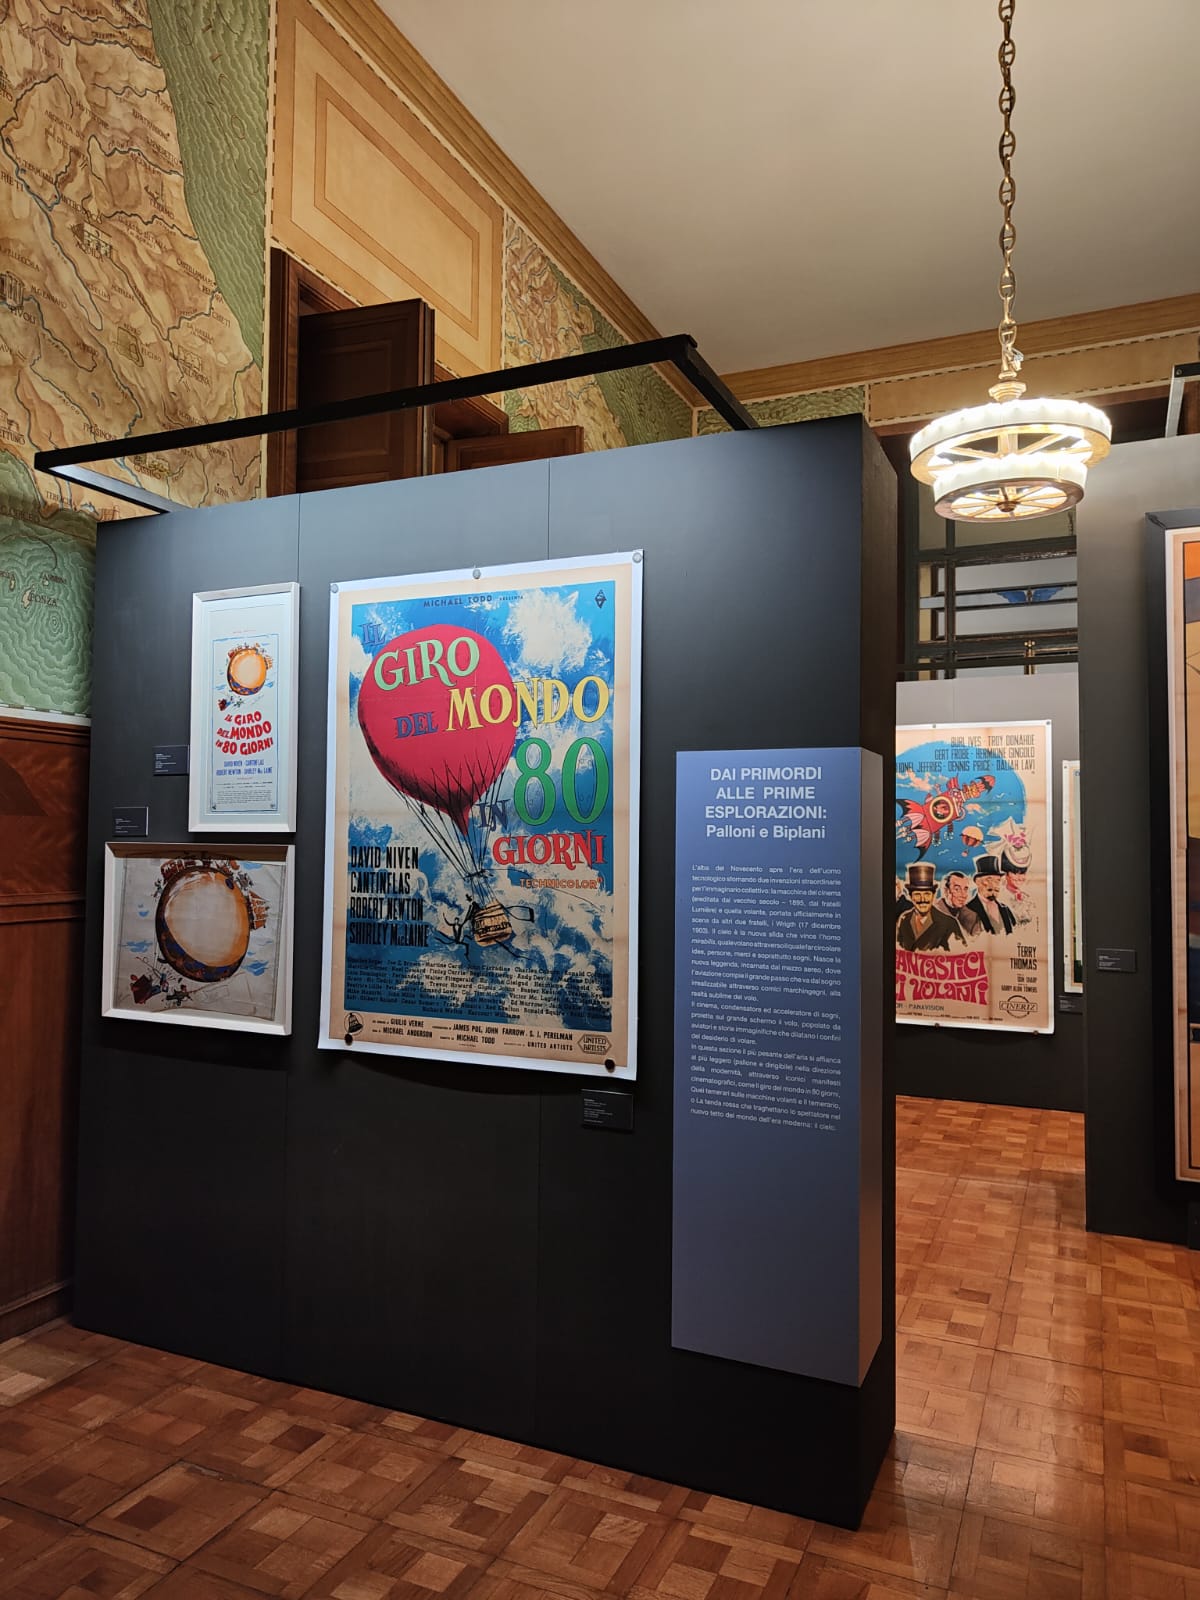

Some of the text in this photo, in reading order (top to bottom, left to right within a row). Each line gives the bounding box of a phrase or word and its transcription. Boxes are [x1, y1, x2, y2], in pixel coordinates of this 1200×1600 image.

[423, 598, 463, 607] MICHAEL
[468, 595, 492, 604] TODD
[361, 623, 387, 646] IL
[373, 636, 480, 691] GIRO
[394, 675, 610, 739] DEL MONDO
[235, 711, 262, 725] GIRO
[230, 721, 271, 740] MONDO
[222, 741, 237, 754] 80
[240, 737, 273, 755] GIORNI
[967, 736, 981, 747] IVES
[988, 735, 1003, 747] TROY
[897, 762, 915, 773] IONEL
[948, 760, 970, 772] DENNIS
[1021, 759, 1035, 770] LAVI
[711, 767, 822, 781] DAI PRIMORDI
[477, 737, 609, 831] IN 80
[716, 787, 815, 799] ALLE PRIME
[705, 806, 827, 819] ESPLORAZIONI:
[707, 825, 825, 841] Palloni e Biplani
[493, 830, 607, 870] GIORNI
[352, 847, 419, 869] DAVID NIVEN
[351, 872, 410, 895] CANTINFLAS
[350, 897, 423, 921] ROBERT NEWTON
[350, 922, 388, 945] SHIRLEY
[1017, 946, 1036, 958] TERRY
[710, 960, 740, 970] leggenda,
[1010, 958, 1037, 970] THOMAS
[1000, 1002, 1036, 1011] CINERIZ
[391, 1018, 406, 1026] GIULIO
[409, 1020, 424, 1028] VERNE
[453, 1024, 469, 1032] JAMES
[544, 1031, 573, 1040] PERELMAN
[383, 1027, 404, 1035] MICHAEL
[407, 1029, 432, 1038] ANDERSON
[457, 1034, 479, 1043] MICHAEL
[482, 1036, 495, 1044] TODD
[528, 1041, 546, 1049] UNITED
[550, 1043, 573, 1051] ARTISTS
[583, 1035, 606, 1045] UNITED
[583, 1043, 607, 1053] ARTISTS
[748, 1070, 780, 1080] attraverso
[736, 1113, 758, 1121] mondo
